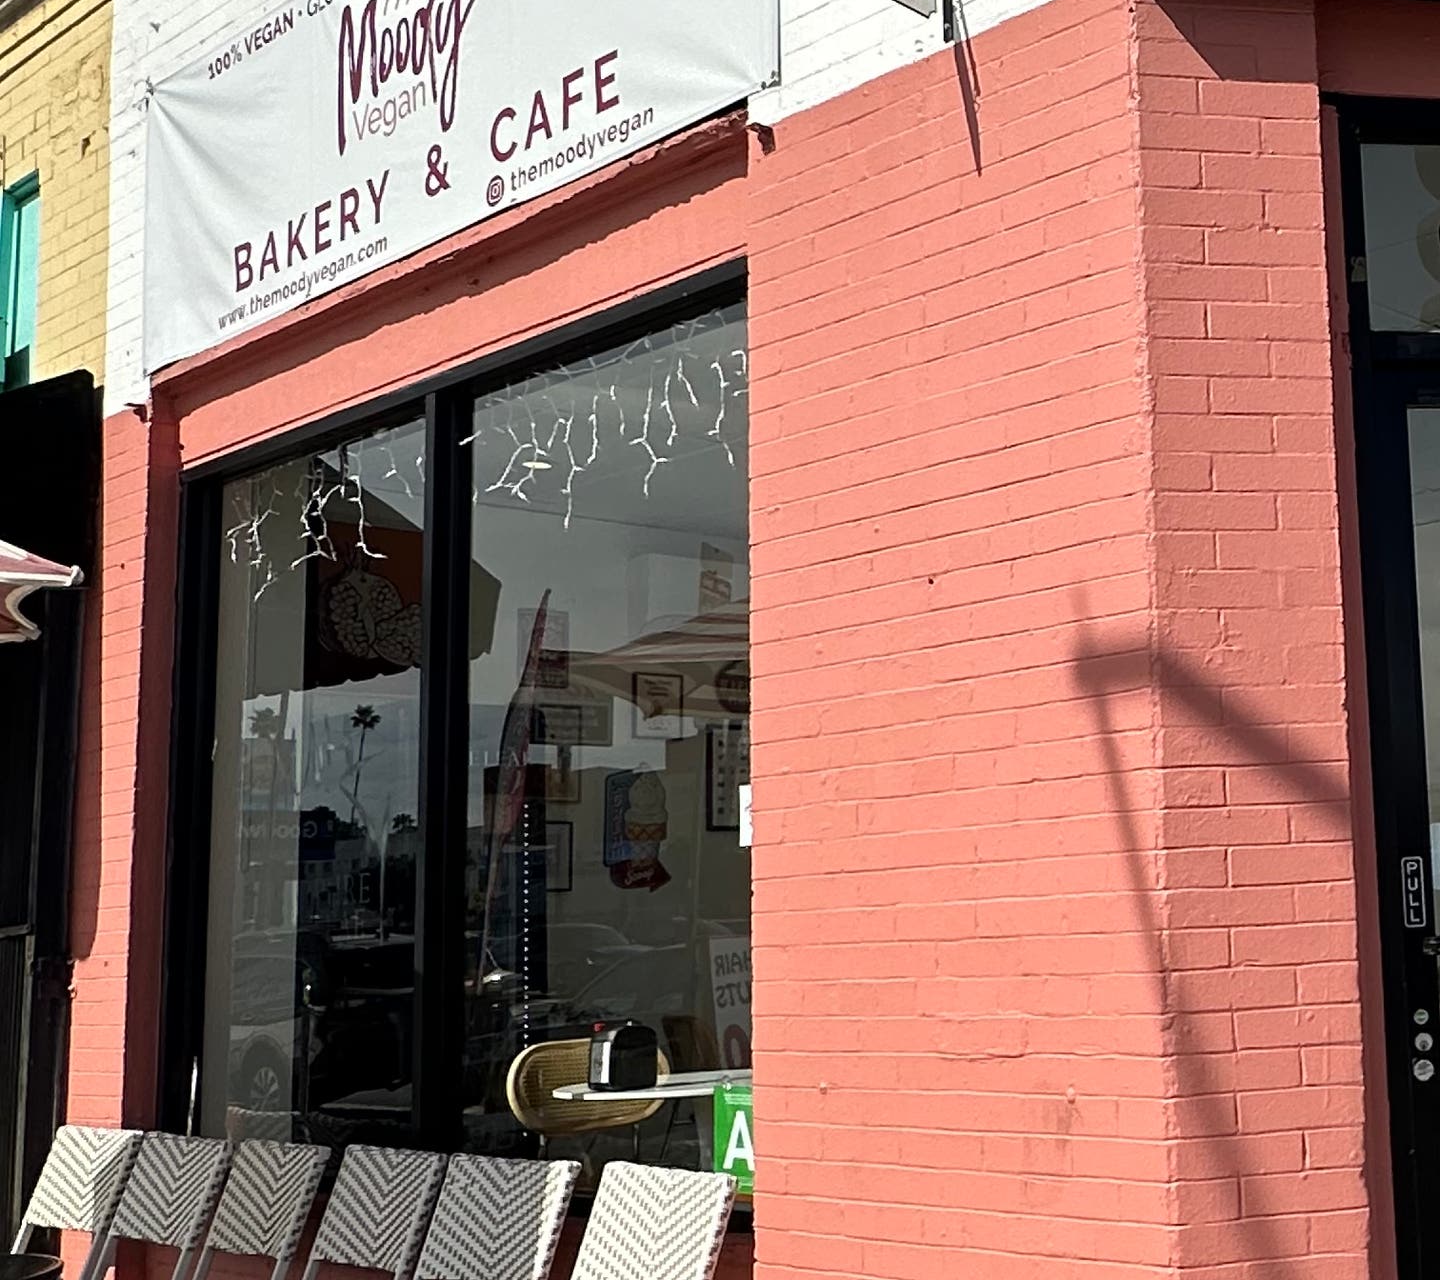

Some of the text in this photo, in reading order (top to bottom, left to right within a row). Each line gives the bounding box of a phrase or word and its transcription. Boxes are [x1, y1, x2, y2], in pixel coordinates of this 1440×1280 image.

[207, 43, 242, 79] 100%
[244, 8, 294, 55] VEGAN
[353, 81, 426, 140] Vegan
[234, 50, 619, 292] BAKERY & CAFE
[510, 106, 654, 192] themoodyvegan
[218, 235, 388, 330] www.themoodyvegan.com
[1406, 861, 1420, 922] PULL
[723, 1110, 753, 1170] A
